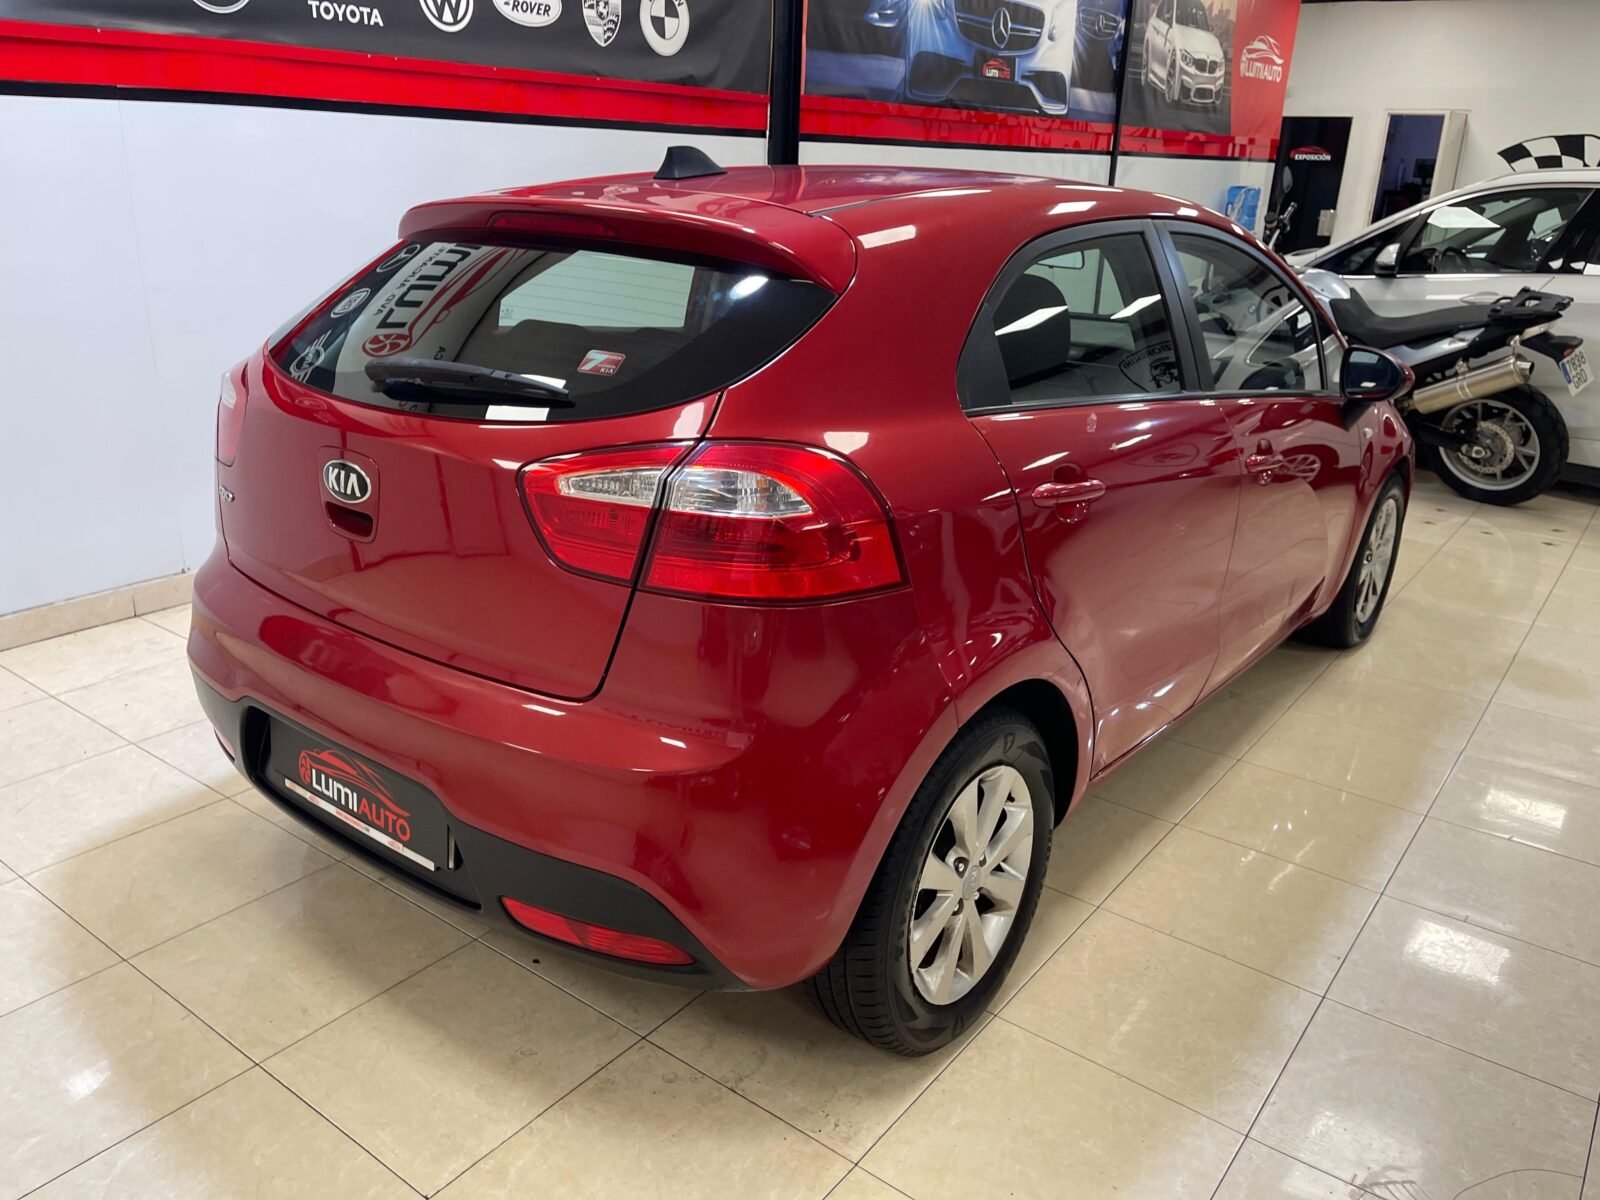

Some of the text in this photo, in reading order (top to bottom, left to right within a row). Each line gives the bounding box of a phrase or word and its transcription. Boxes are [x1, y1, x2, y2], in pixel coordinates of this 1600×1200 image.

[307, 0, 384, 27] TOYOTA
[1294, 152, 1332, 161] EXPOSICIÓN
[328, 465, 362, 498] KIA
